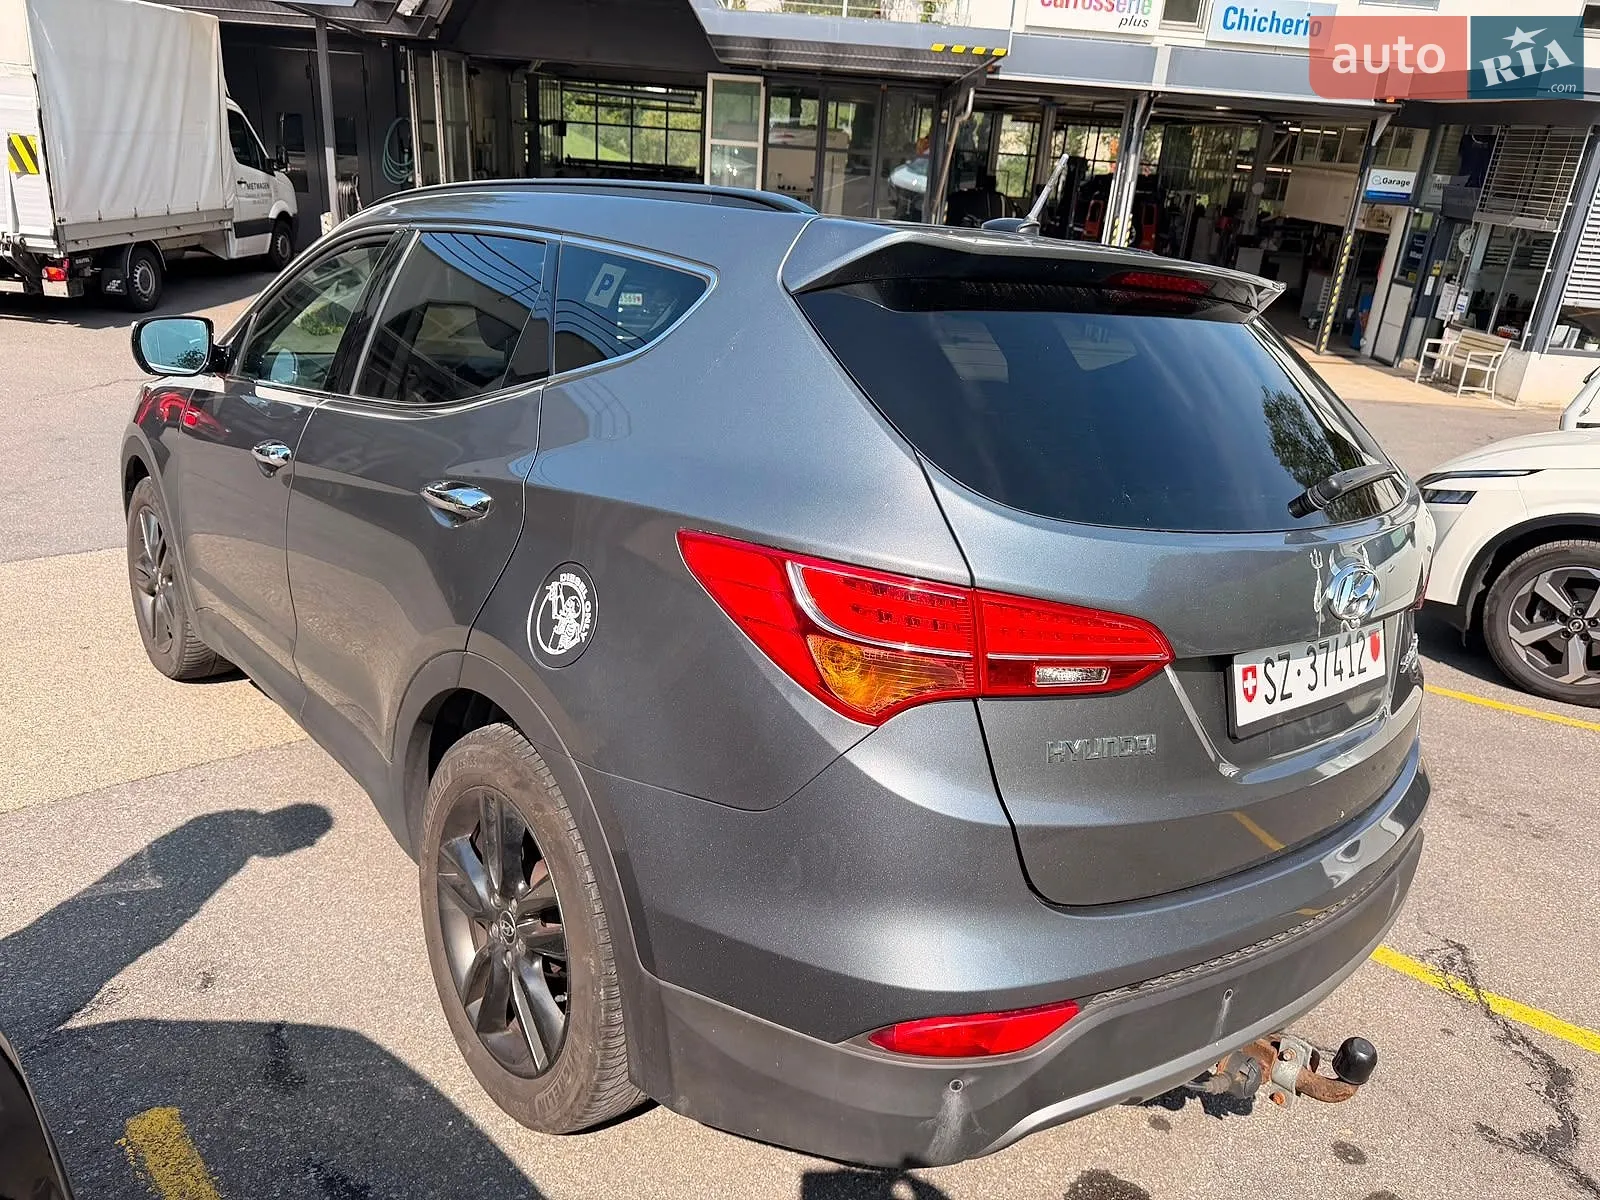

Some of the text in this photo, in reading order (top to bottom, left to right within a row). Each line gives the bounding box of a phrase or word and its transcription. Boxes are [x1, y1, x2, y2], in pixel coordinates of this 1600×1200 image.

[1118, 14, 1150, 28] plus
[1222, 5, 1322, 38] Chicherio
[1046, 734, 1157, 763] HYUNDAI
